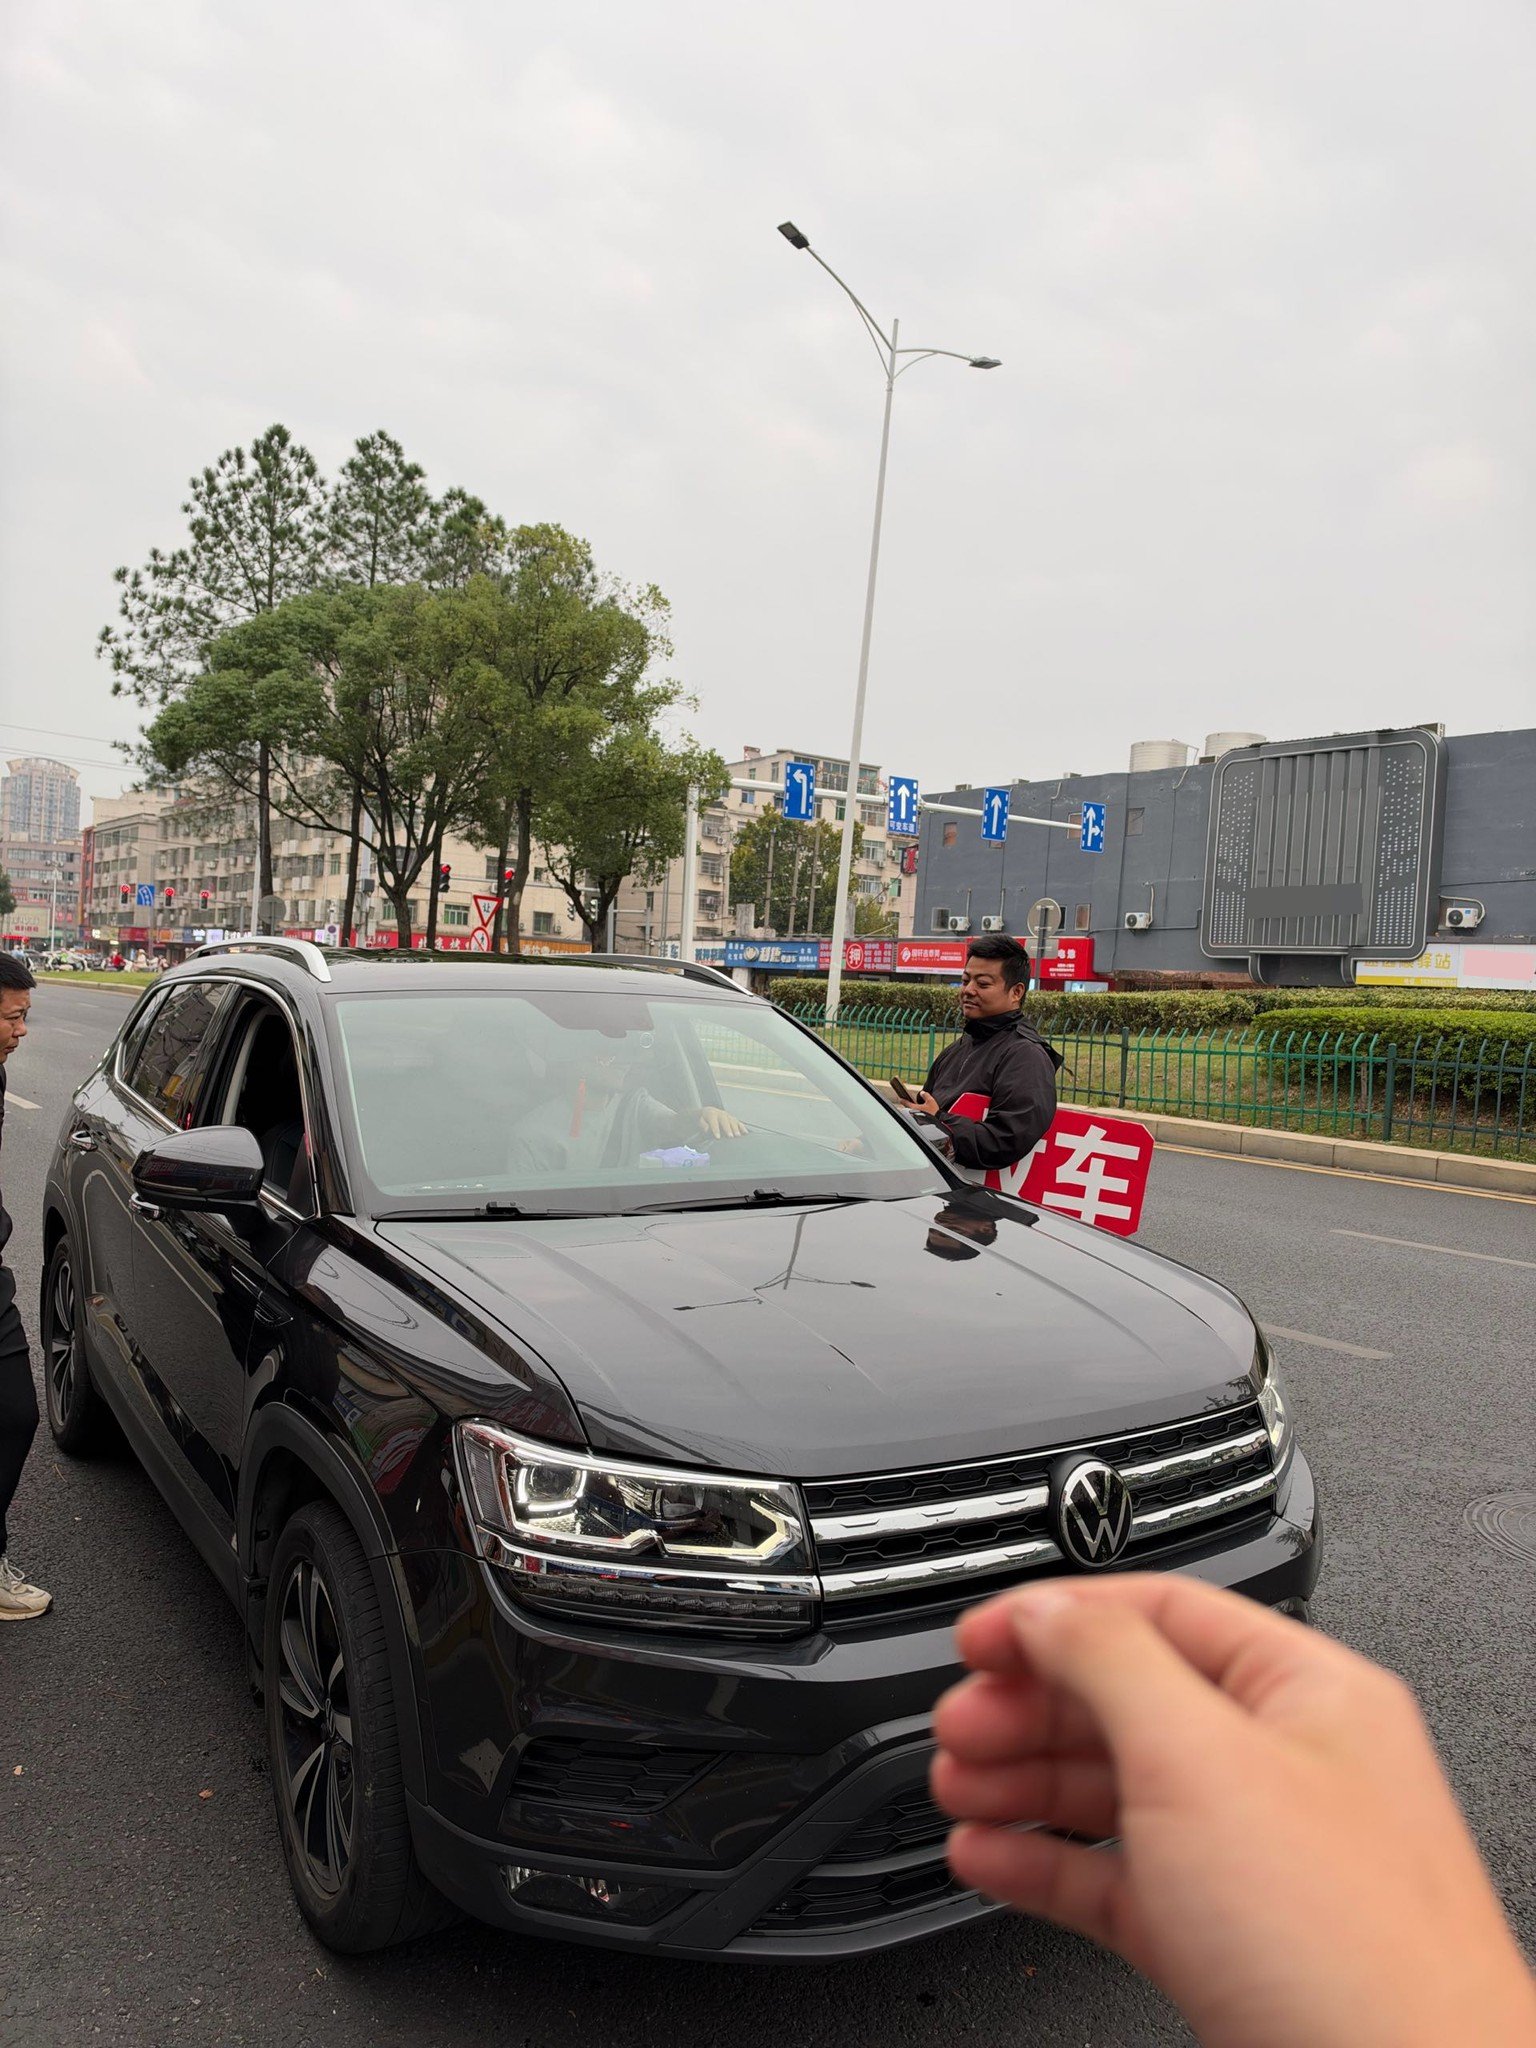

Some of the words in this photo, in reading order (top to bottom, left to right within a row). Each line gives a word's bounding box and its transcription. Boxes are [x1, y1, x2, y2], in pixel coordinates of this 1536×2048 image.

[889, 821, 914, 833] 可变车道
[483, 903, 491, 913] 让
[849, 948, 861, 965] 押
